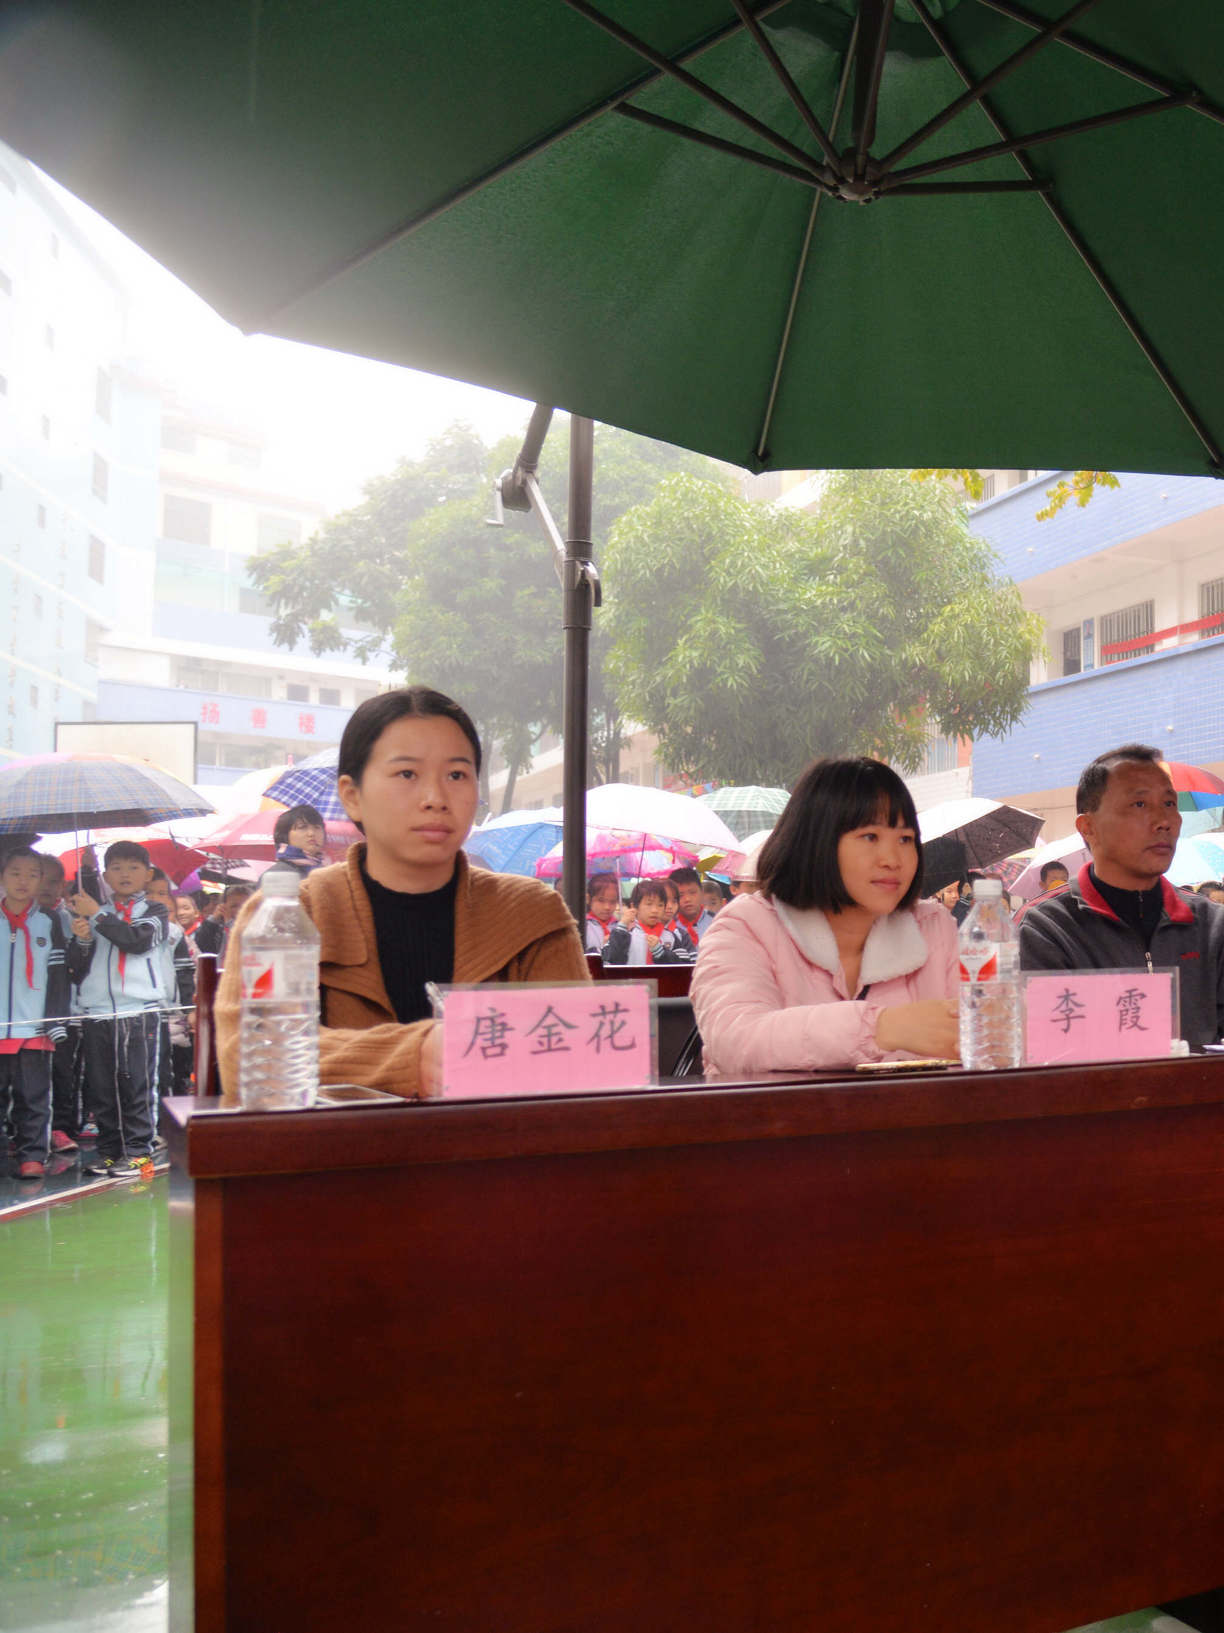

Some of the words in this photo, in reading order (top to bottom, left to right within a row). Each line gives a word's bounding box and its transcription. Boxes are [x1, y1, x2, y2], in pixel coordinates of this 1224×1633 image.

[463, 1000, 638, 1060] 唐金花
[1050, 987, 1149, 1034] 李霞
